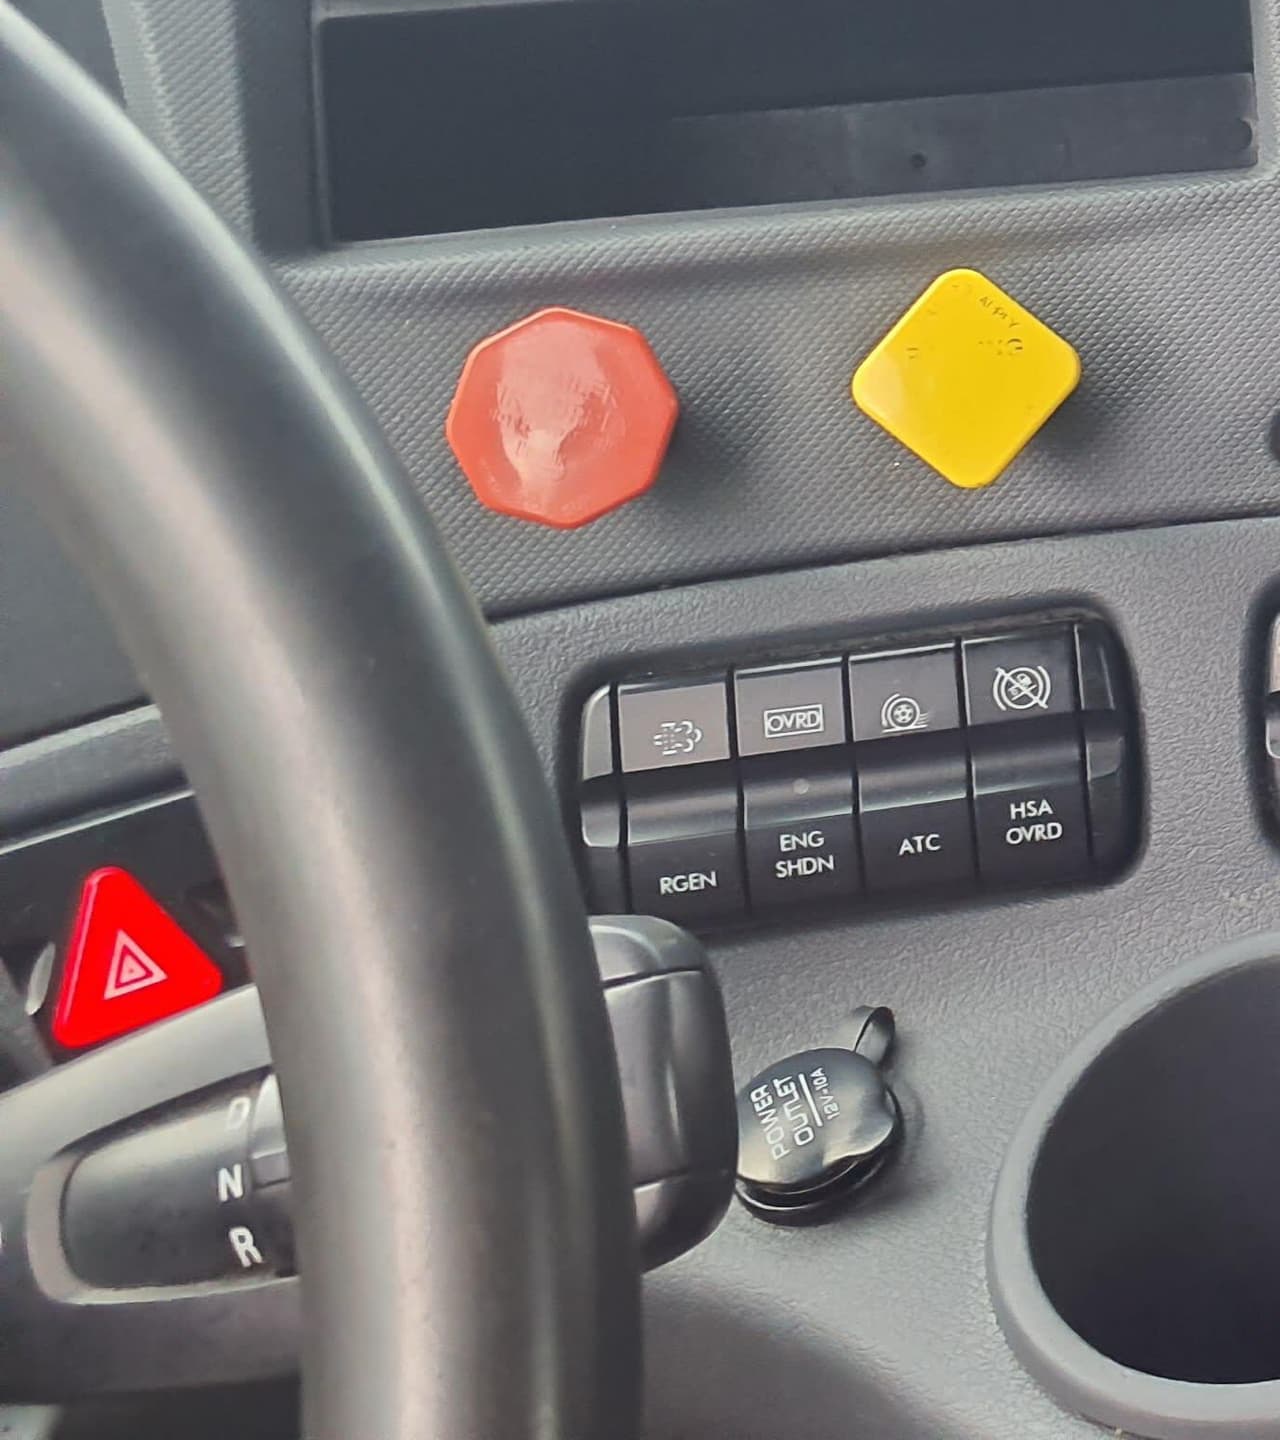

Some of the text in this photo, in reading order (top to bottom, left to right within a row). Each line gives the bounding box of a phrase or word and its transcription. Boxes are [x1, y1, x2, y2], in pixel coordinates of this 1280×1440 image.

[768, 711, 820, 731] OVRD
[1010, 799, 1053, 820] HSA
[780, 831, 825, 852] ENG
[898, 834, 941, 856] ATC
[1005, 822, 1063, 846] OVRD
[775, 855, 835, 879] SHDN
[659, 871, 717, 896] RGEN
[750, 1084, 791, 1160] POWER
[772, 1076, 815, 1146] OUTLET
[217, 1163, 244, 1202] N
[228, 1226, 263, 1268] R
